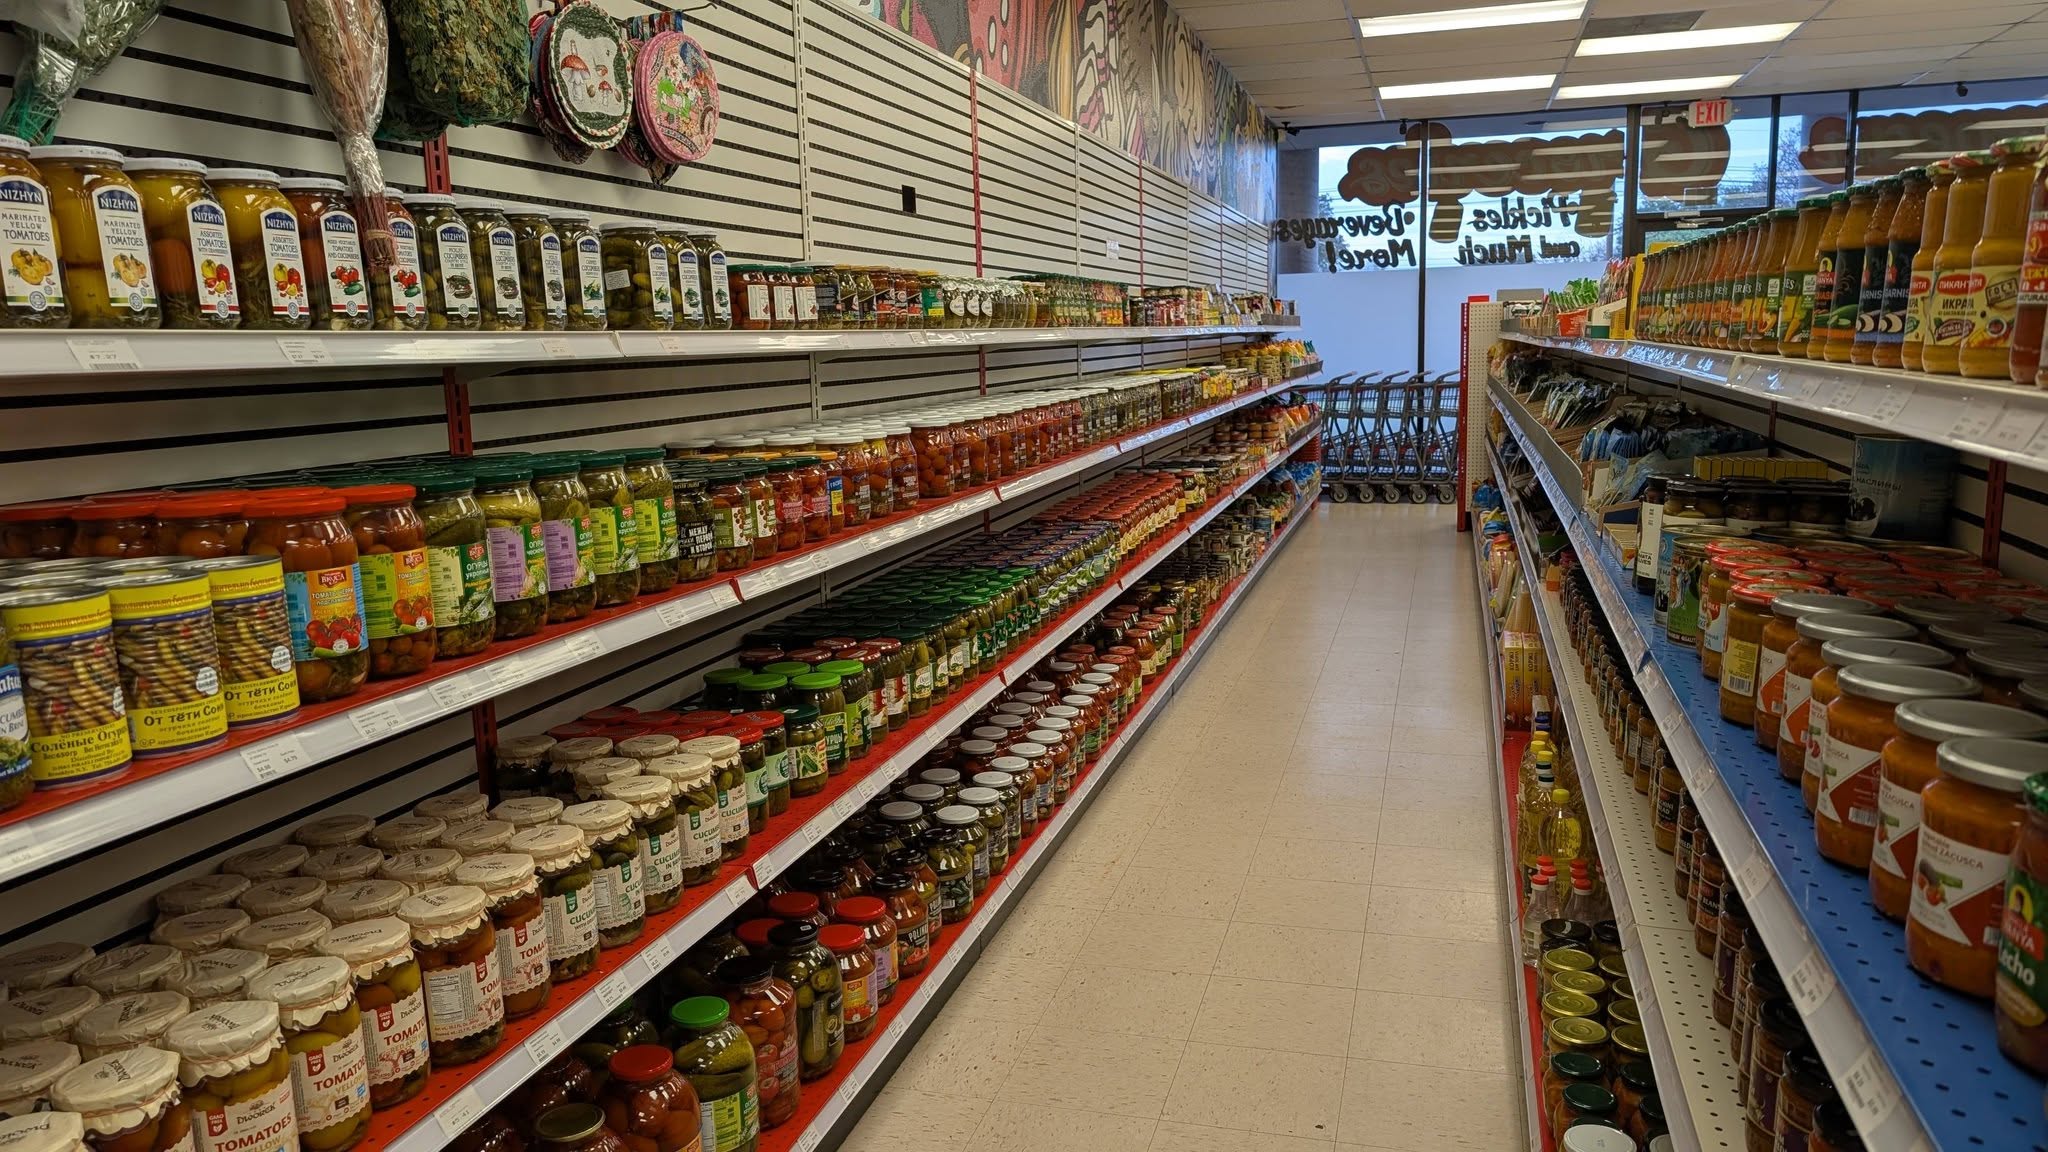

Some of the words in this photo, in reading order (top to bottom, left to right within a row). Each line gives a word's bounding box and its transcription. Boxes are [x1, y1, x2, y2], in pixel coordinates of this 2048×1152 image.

[1696, 101, 1727, 125] EXIT
[0, 189, 42, 203] NIZHYN
[100, 197, 138, 211] NIZHYN
[1, 212, 47, 223] MARINATED
[193, 211, 224, 224] NIZHYN
[10, 221, 42, 229] YELLOW
[103, 220, 141, 229] MARINATED
[266, 218, 295, 230] NIZHYN
[326, 222, 354, 231] NIZHYN
[3, 229, 50, 242] TOMATOES
[111, 227, 137, 235] YELLOW
[200, 230, 224, 239] ASSORTED
[105, 235, 144, 247] TOMATOES
[272, 236, 295, 244] ASSORTED
[442, 232, 466, 242] NIZHYN
[493, 236, 514, 246] NIZHYN
[197, 238, 227, 249] TOMATOES
[269, 244, 298, 254] TOMATOES
[544, 240, 560, 250] NIZHYN
[580, 244, 598, 252] NIZHYN
[444, 252, 468, 261] CUCUMBERS
[688, 526, 708, 537] МЕЖДУ
[224, 690, 240, 701] От
[246, 684, 276, 697] тёти
[144, 715, 163, 727] От
[168, 710, 200, 723] тёти
[31, 735, 94, 754] Солёные
[1938, 848, 1984, 870] ZACUSCA
[214, 1112, 292, 1152] TOMATOES
